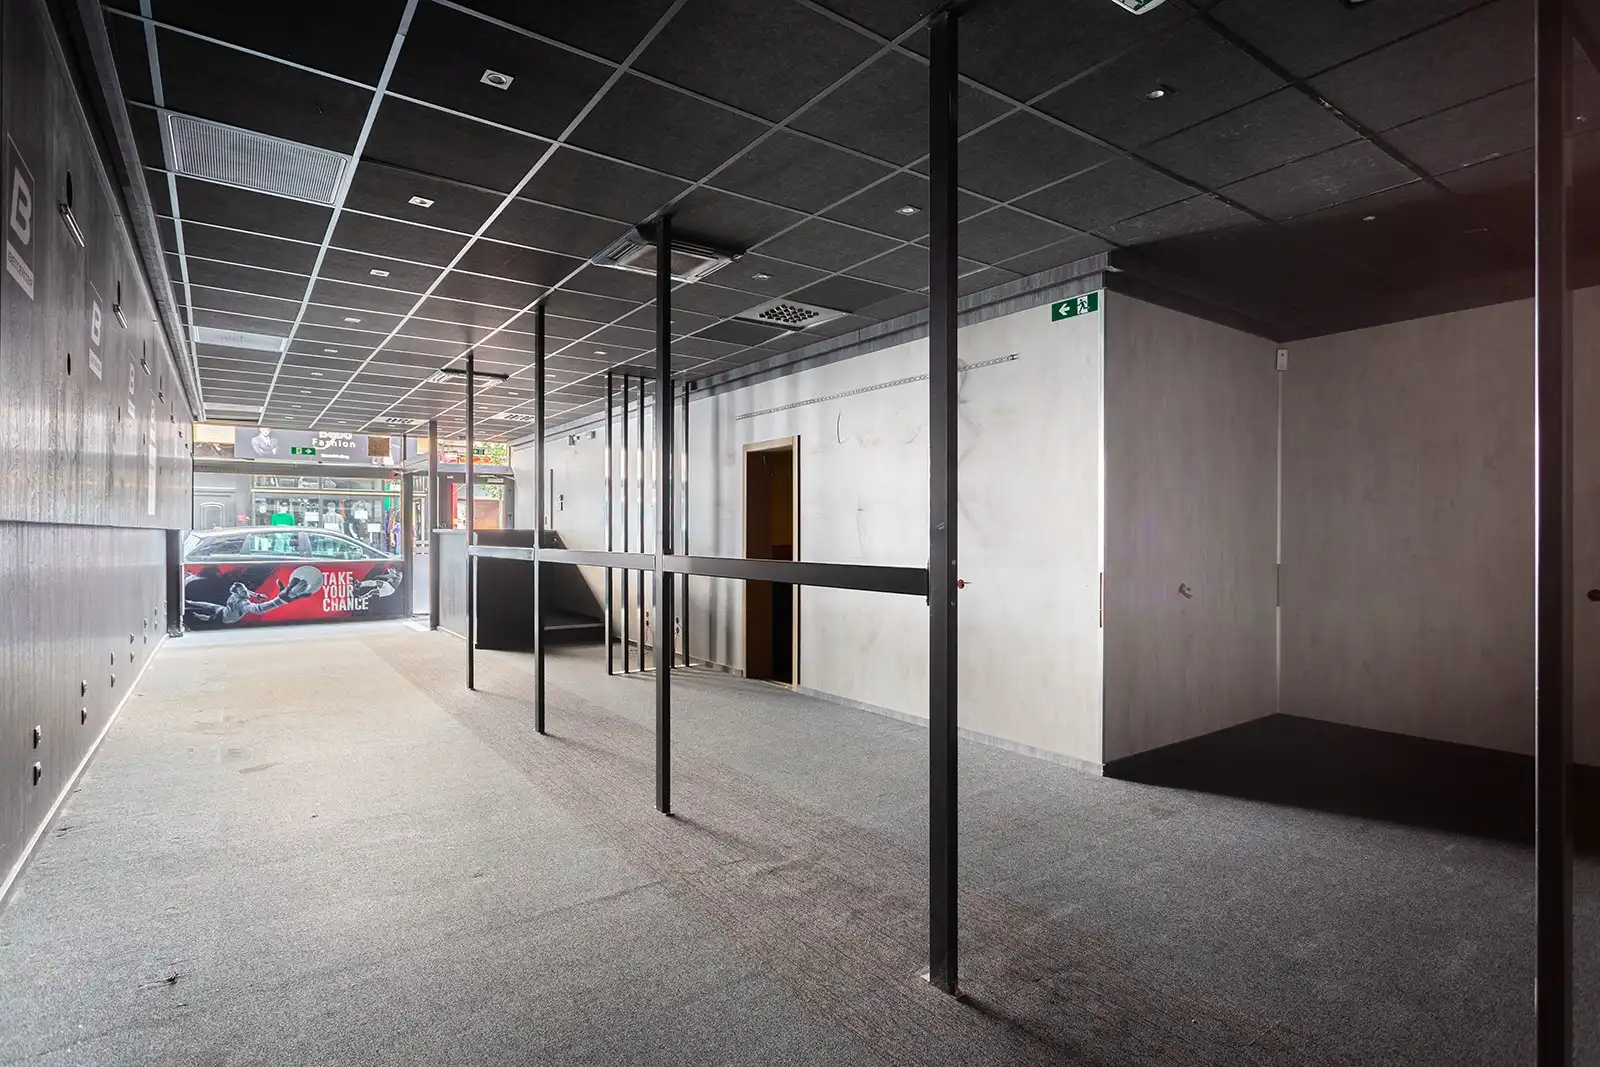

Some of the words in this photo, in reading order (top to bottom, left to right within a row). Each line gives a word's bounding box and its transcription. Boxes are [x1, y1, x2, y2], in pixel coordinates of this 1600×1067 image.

[10, 166, 32, 245] B
[91, 300, 101, 346] B
[322, 571, 354, 586] TAKE
[322, 584, 355, 599] YOUR
[322, 597, 369, 612] CHANCE
